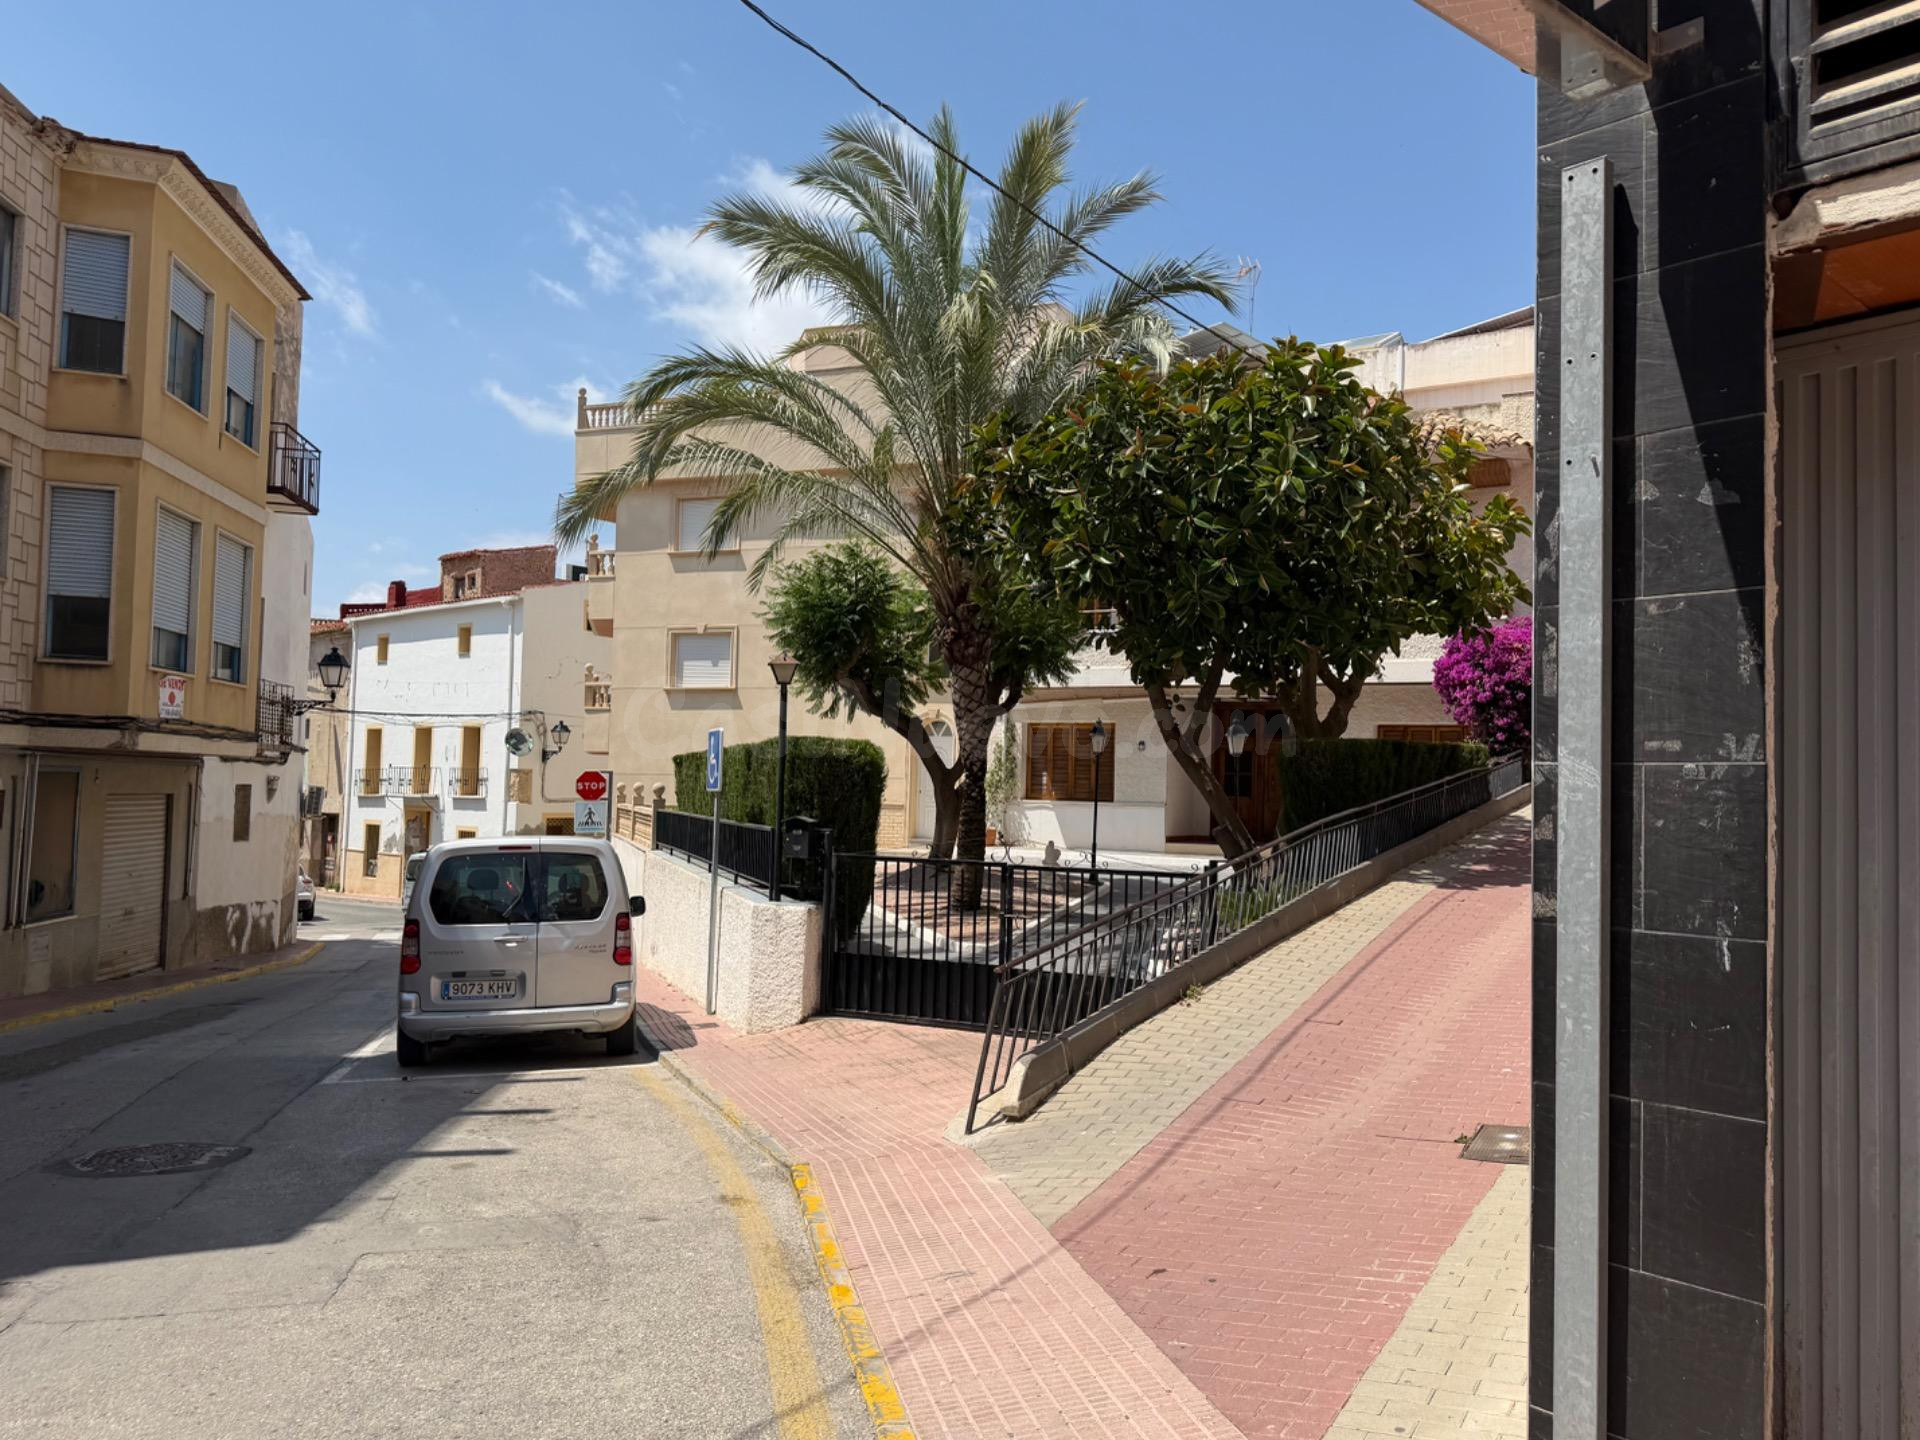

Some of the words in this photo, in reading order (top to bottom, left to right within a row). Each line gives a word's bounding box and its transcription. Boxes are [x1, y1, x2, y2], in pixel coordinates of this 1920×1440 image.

[577, 782, 605, 790] STOP
[452, 983, 484, 995] 9073
[488, 982, 512, 993] KHV
